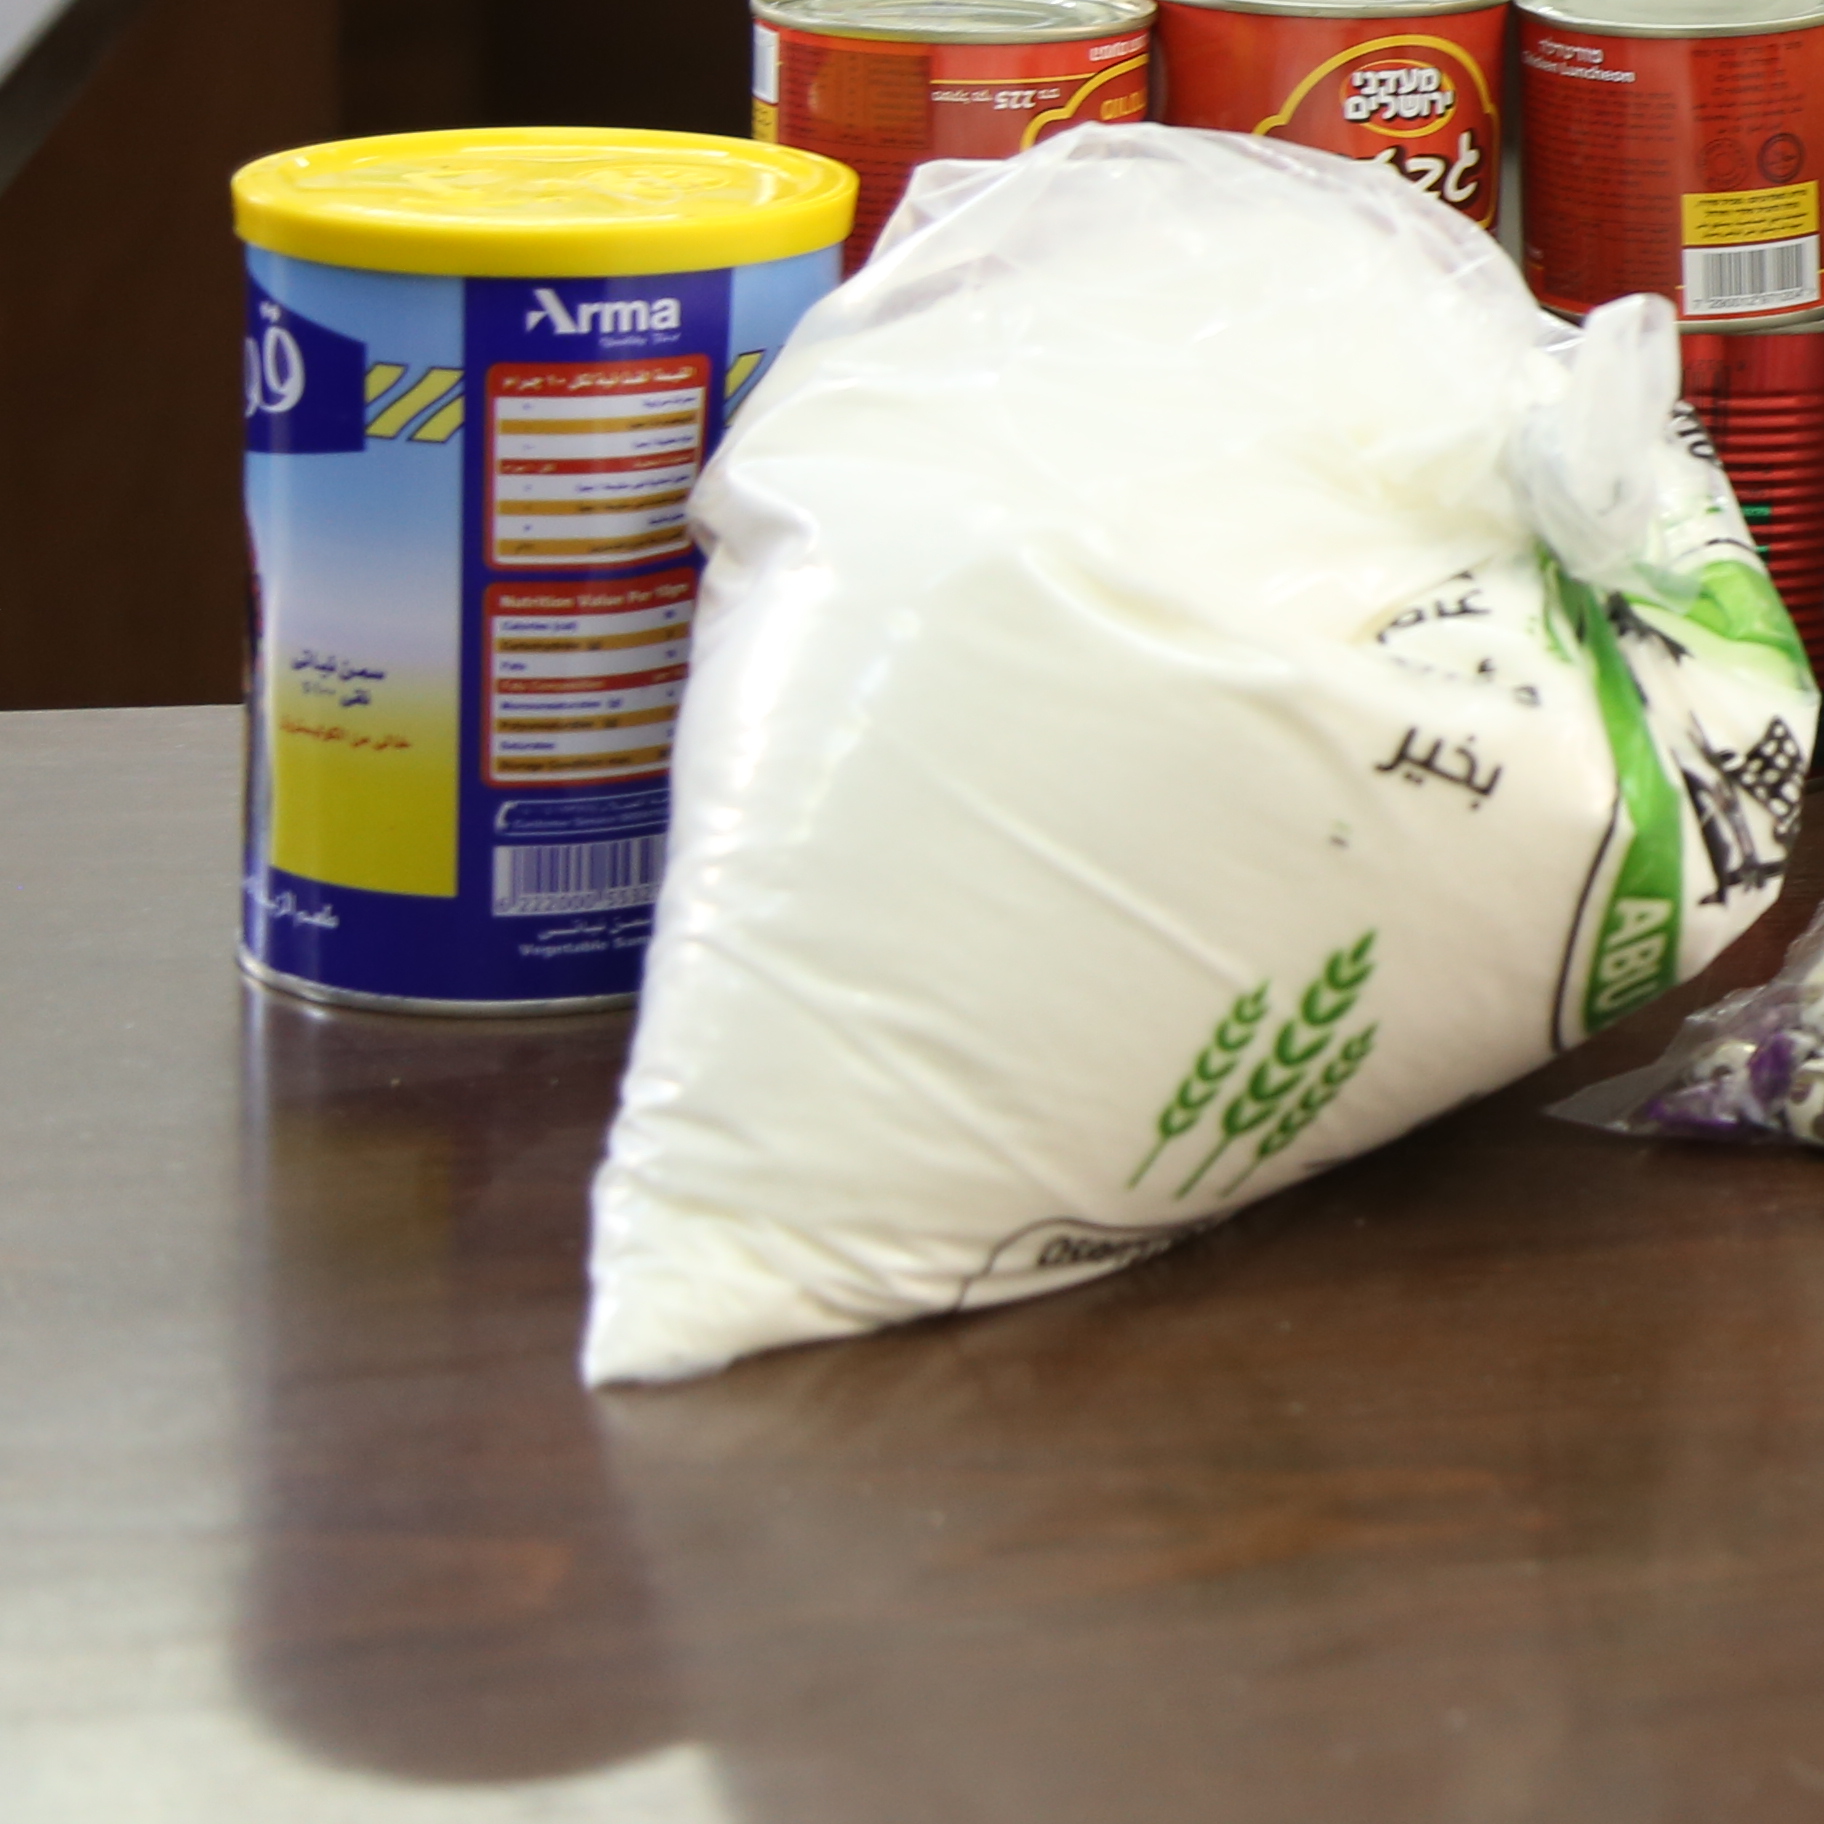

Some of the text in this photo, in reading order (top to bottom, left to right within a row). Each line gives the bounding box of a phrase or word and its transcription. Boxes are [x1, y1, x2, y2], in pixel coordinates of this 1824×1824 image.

[1351, 66, 1443, 96] מעדני
[993, 87, 1037, 111] 225
[1343, 89, 1456, 121] ירושלים
[524, 287, 681, 335] Arma
[500, 595, 575, 609] Nutrition
[576, 594, 625, 608] Value
[626, 590, 653, 604] Per
